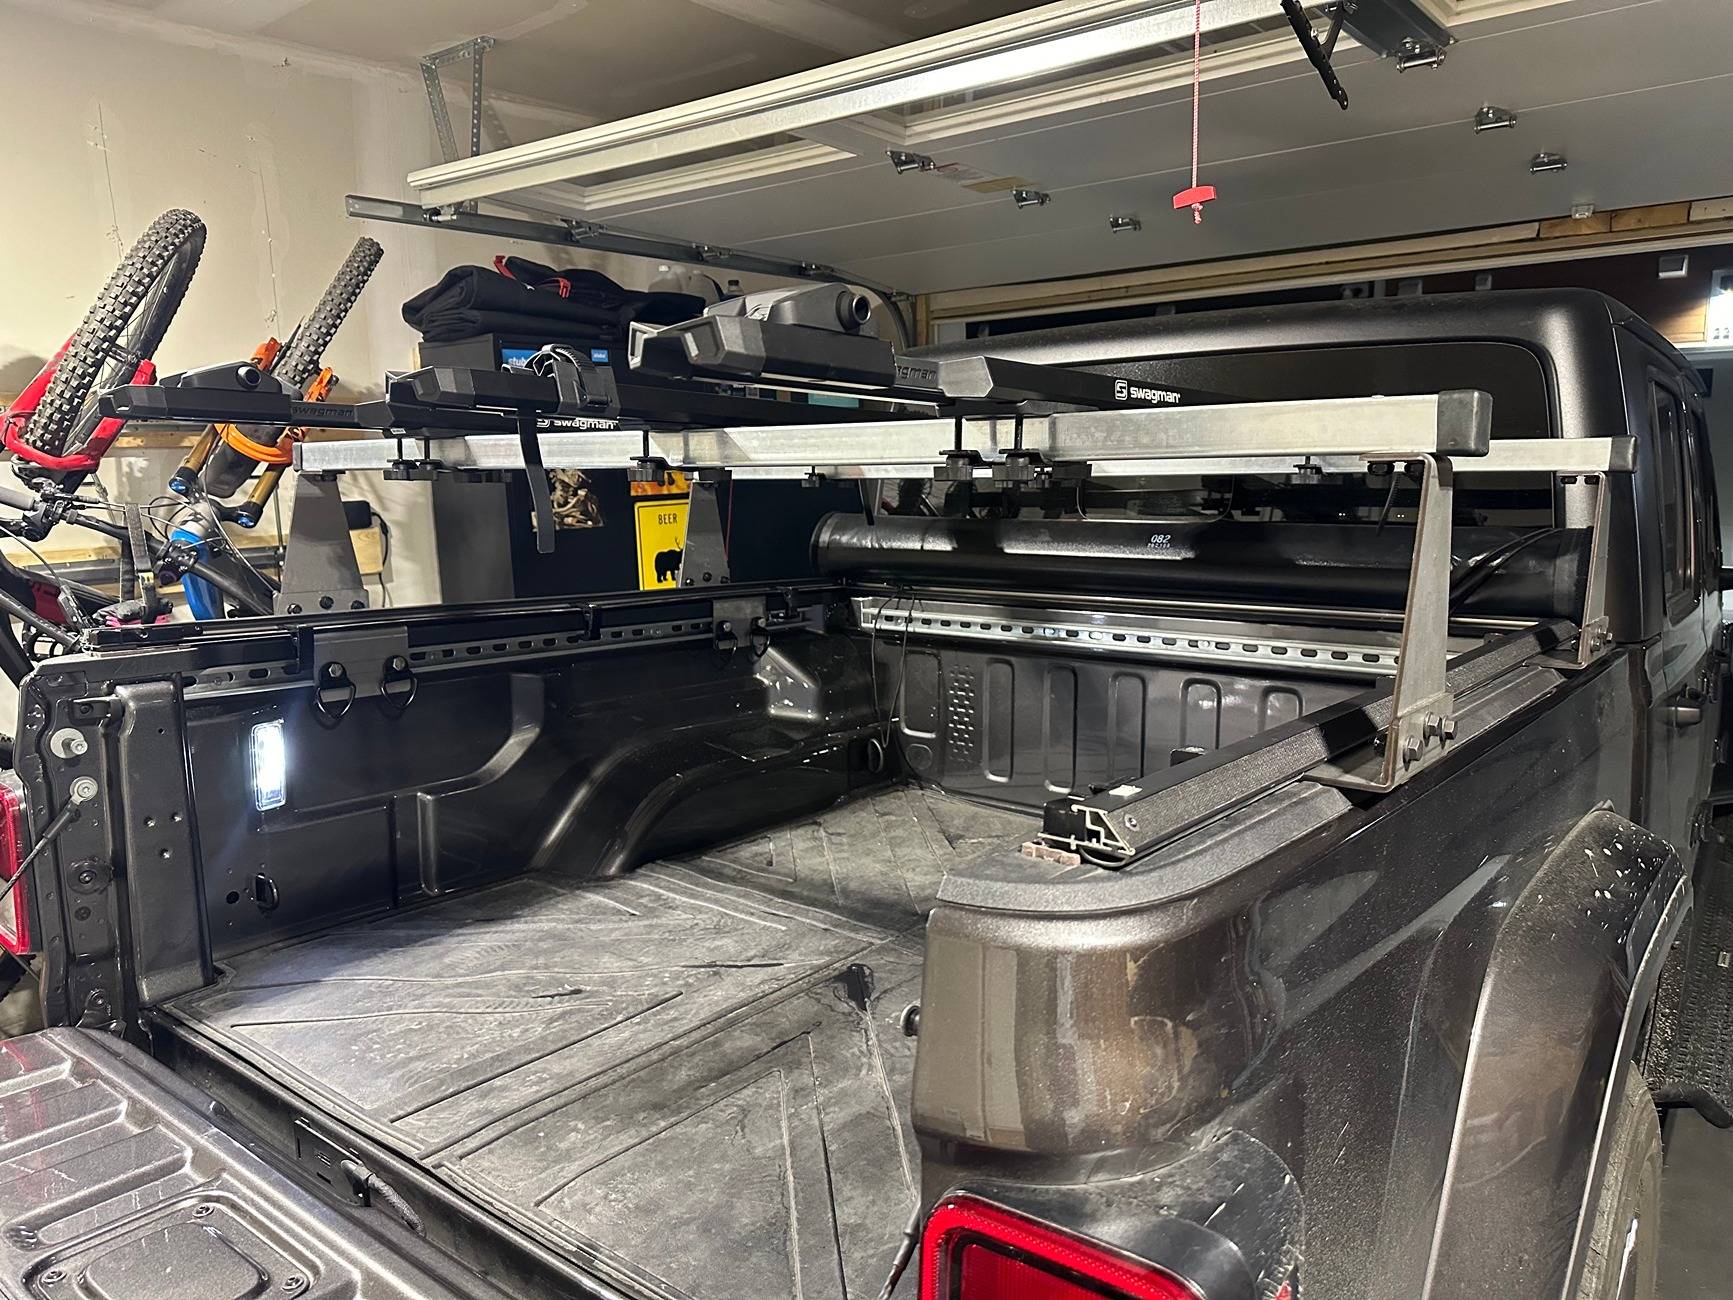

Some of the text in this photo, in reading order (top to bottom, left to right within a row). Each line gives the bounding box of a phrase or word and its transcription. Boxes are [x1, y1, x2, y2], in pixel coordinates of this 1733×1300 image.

[1130, 386, 1180, 404] swagman
[658, 513, 678, 525] BEER
[1150, 534, 1171, 543] 082
